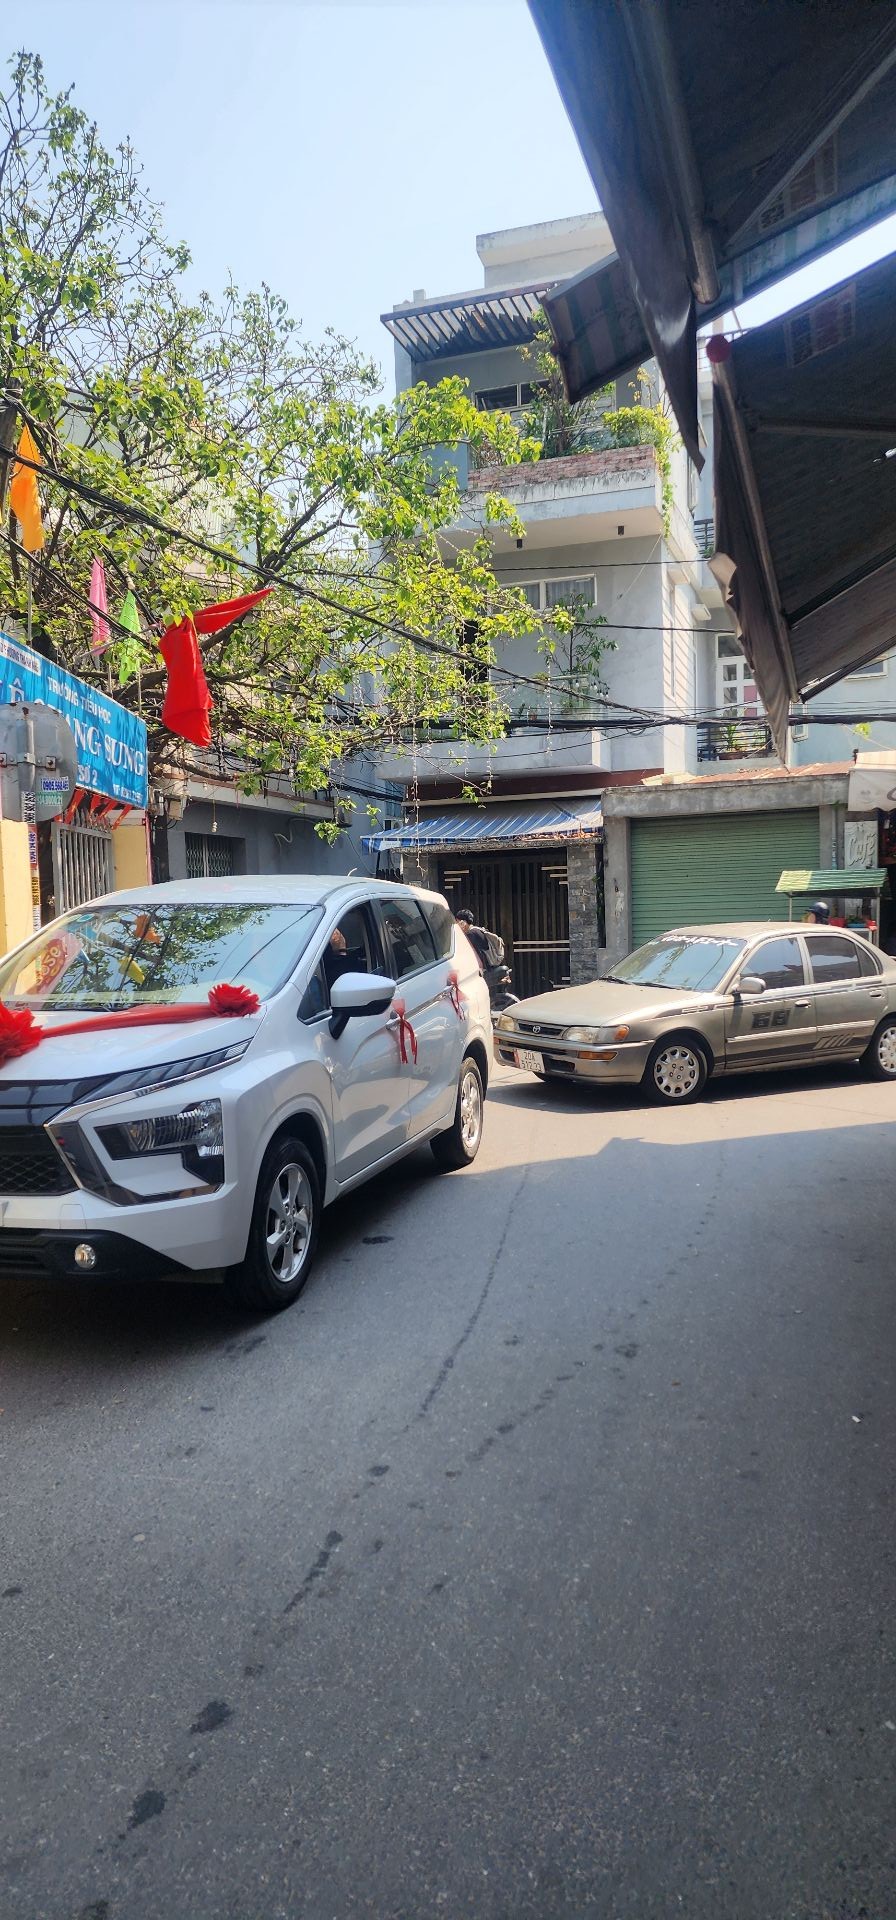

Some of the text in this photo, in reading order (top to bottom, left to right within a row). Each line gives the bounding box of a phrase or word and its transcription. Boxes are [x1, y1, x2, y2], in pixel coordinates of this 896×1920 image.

[47, 676, 79, 707] TRƯỜNG
[80, 693, 98, 717] TIỂU
[78, 763, 98, 786] SỐ 2
[104, 734, 145, 777] SUNG
